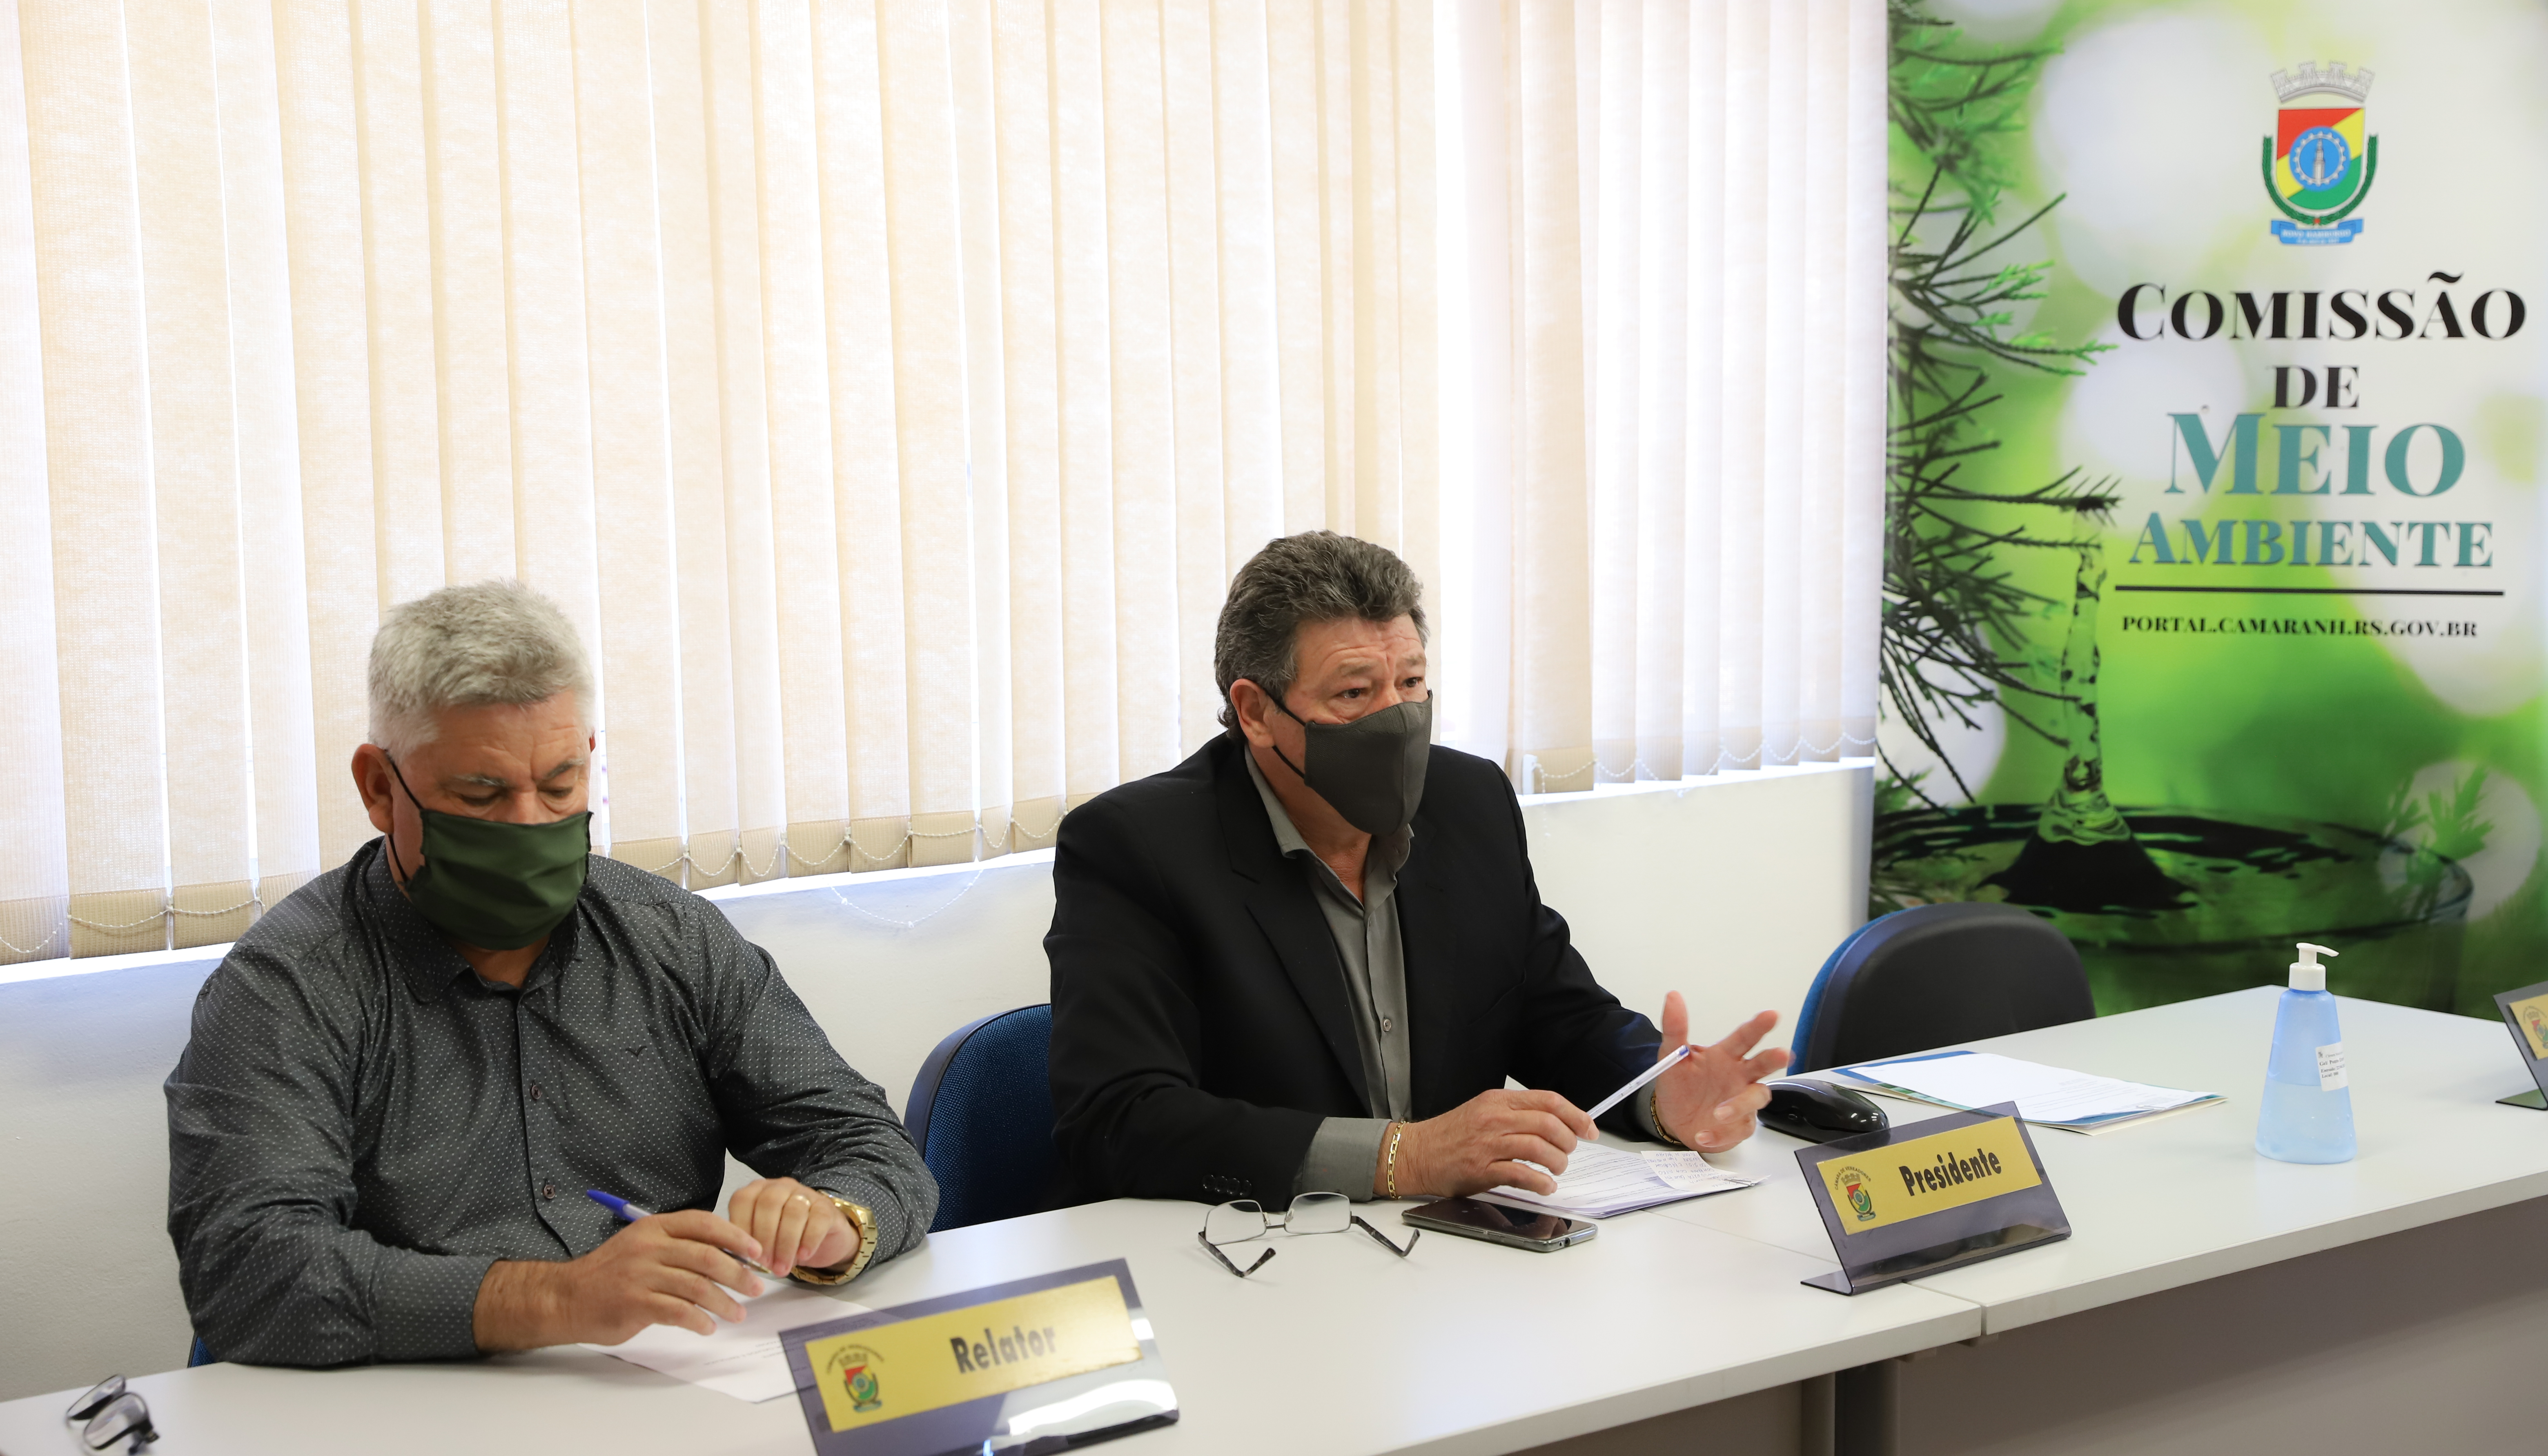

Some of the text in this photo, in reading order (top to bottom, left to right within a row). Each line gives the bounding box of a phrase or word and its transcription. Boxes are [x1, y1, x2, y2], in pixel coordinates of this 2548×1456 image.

[2118, 271, 2526, 341] COMISSÃO
[2273, 365, 2359, 409] DE
[2165, 412, 2465, 496] MEIO
[2129, 512, 2493, 567] AMBIENTE
[2123, 616, 2477, 637] PORTAL.CAMARANH.RS.GOV.BR
[1899, 1148, 2002, 1196] Presidente
[950, 1325, 1058, 1374] Relator
